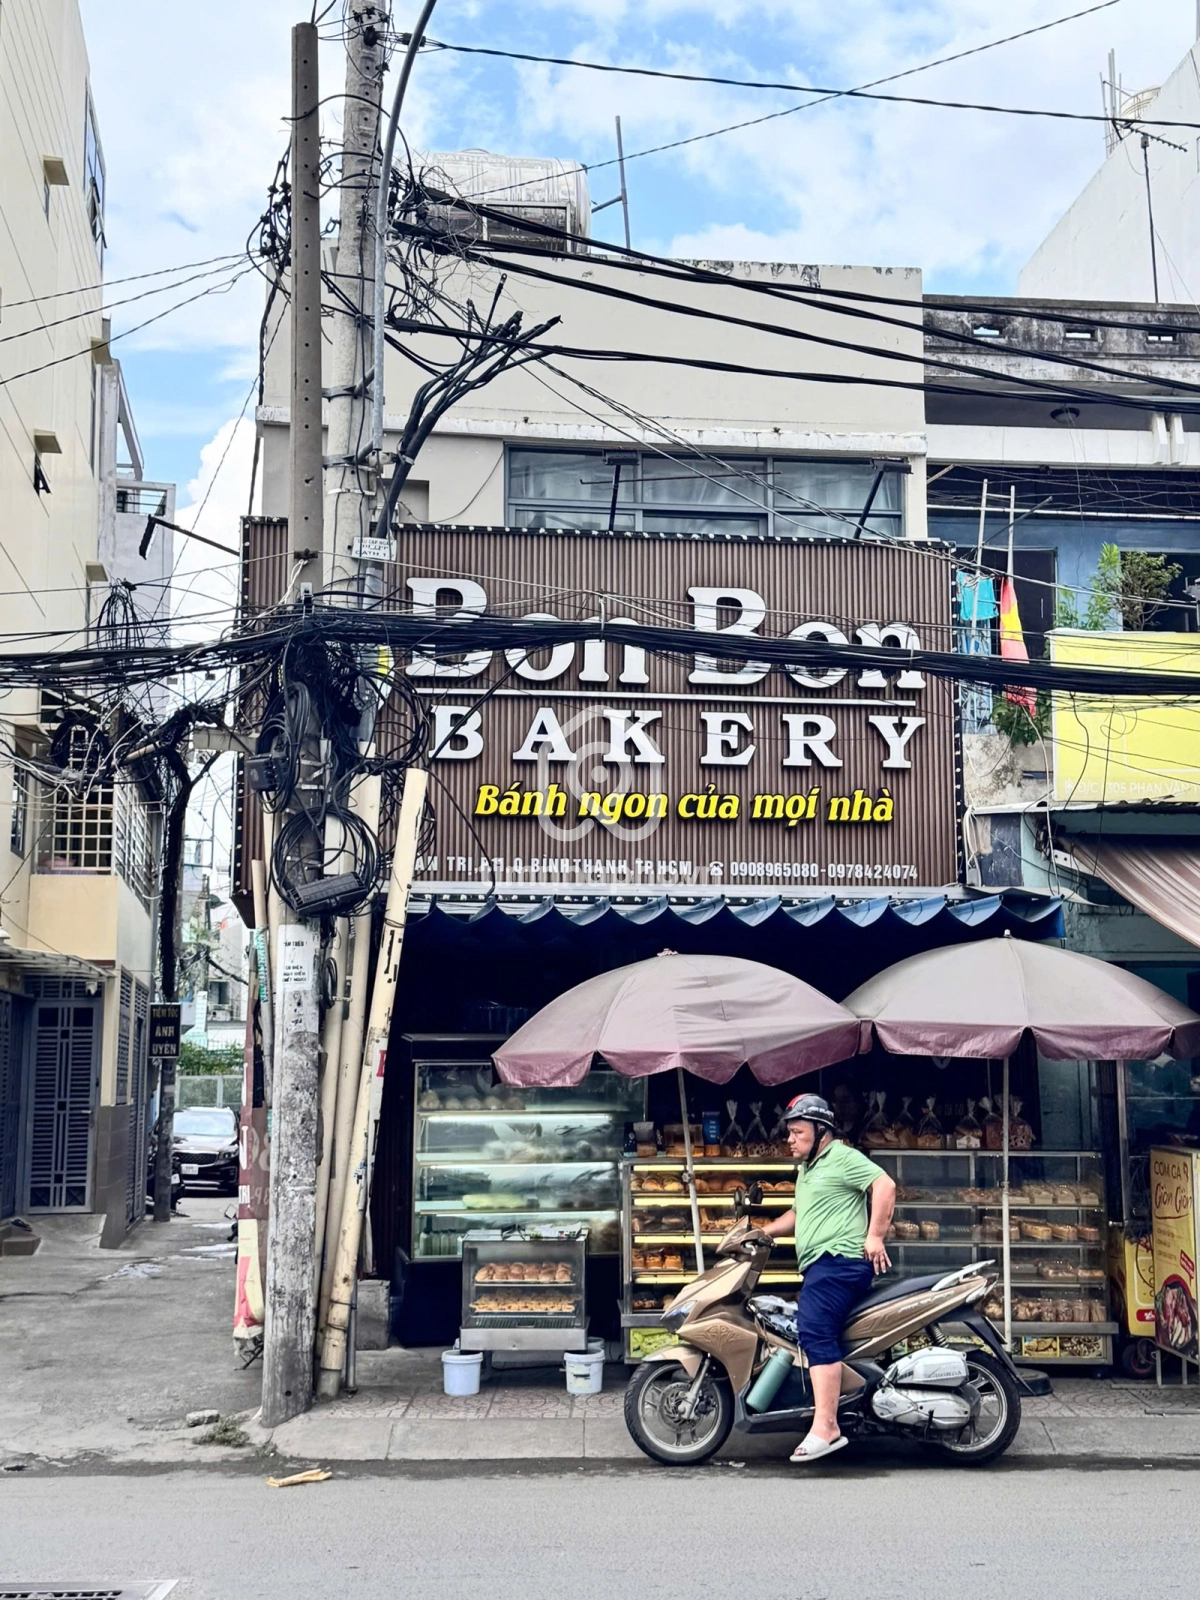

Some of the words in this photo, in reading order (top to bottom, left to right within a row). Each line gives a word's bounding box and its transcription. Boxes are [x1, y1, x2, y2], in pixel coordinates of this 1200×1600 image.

[405, 577, 650, 684] Bon
[687, 586, 927, 690] Bon
[429, 704, 928, 769] BAKERY
[474, 782, 566, 818] Bánh
[577, 790, 668, 826] ngon
[677, 783, 740, 821] của
[751, 787, 818, 829] mọi
[827, 787, 894, 824] nhà
[1108, 782, 1127, 794] 305
[1129, 782, 1162, 794] PHAN
